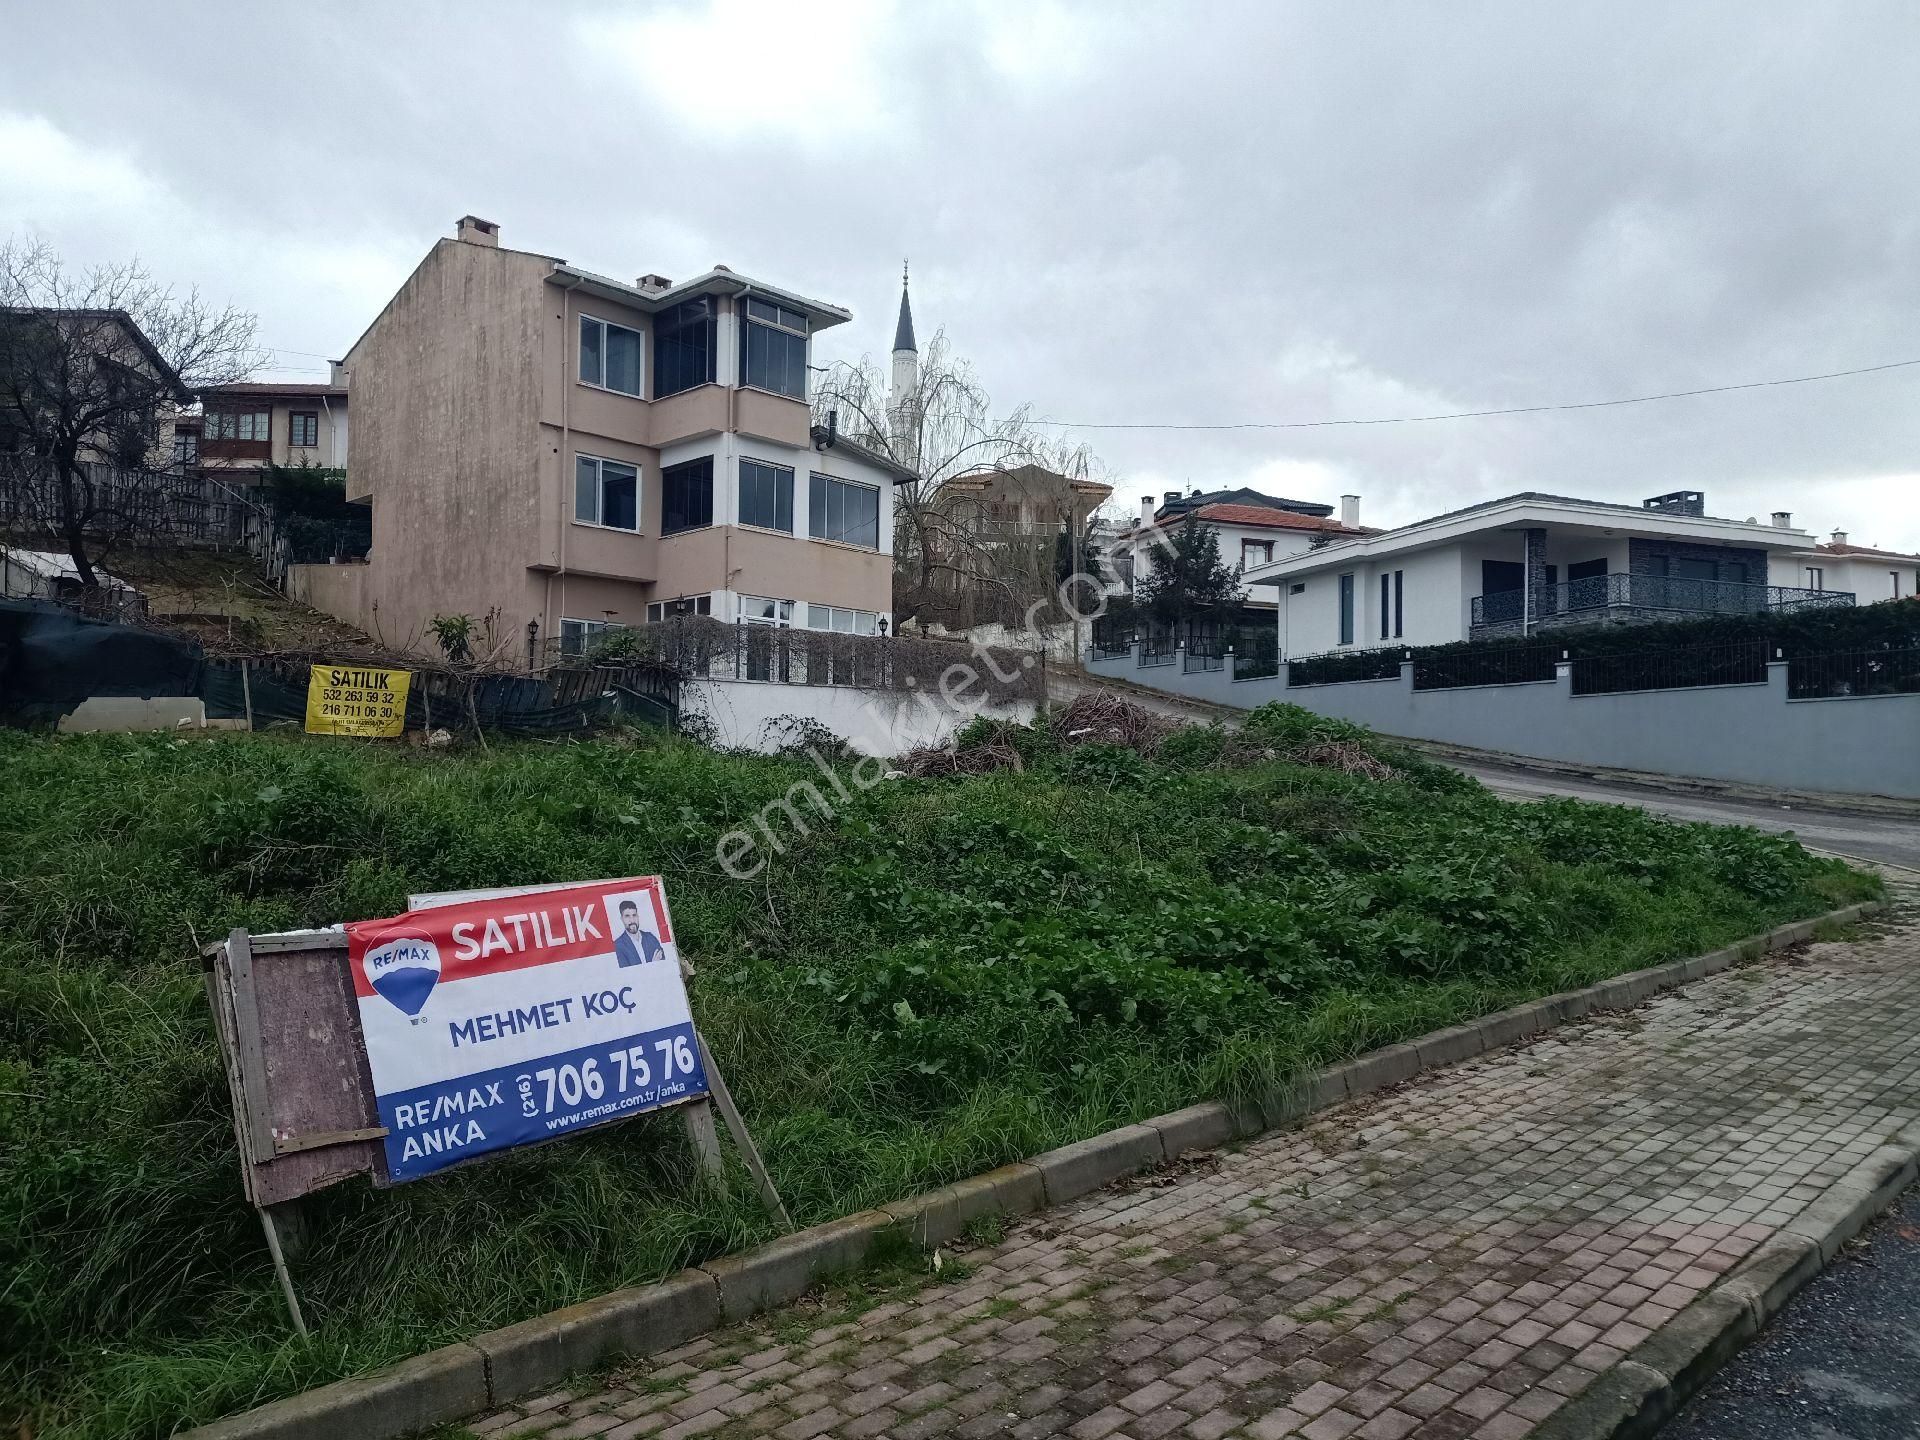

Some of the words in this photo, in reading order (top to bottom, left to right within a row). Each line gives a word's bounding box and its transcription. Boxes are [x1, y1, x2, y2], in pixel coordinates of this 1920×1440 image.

[323, 688, 342, 701] 532
[344, 690, 363, 702] 263
[365, 692, 379, 703] 59
[382, 693, 395, 704] 32
[331, 670, 390, 690] SATILIK
[322, 704, 341, 715] 216
[344, 705, 361, 716] 711
[364, 706, 377, 717] 06
[380, 707, 393, 718] 30
[452, 903, 603, 961] SATILIK
[373, 948, 430, 970] RE/MAX
[449, 998, 573, 1048] MEHMET
[581, 986, 637, 1019] KOÇ
[515, 1074, 540, 1118] (216)
[535, 1057, 605, 1114] 706
[609, 1045, 651, 1093] 75
[655, 1035, 695, 1080] 76
[394, 1081, 504, 1130] RE/MAX
[402, 1119, 487, 1163] ANKA
